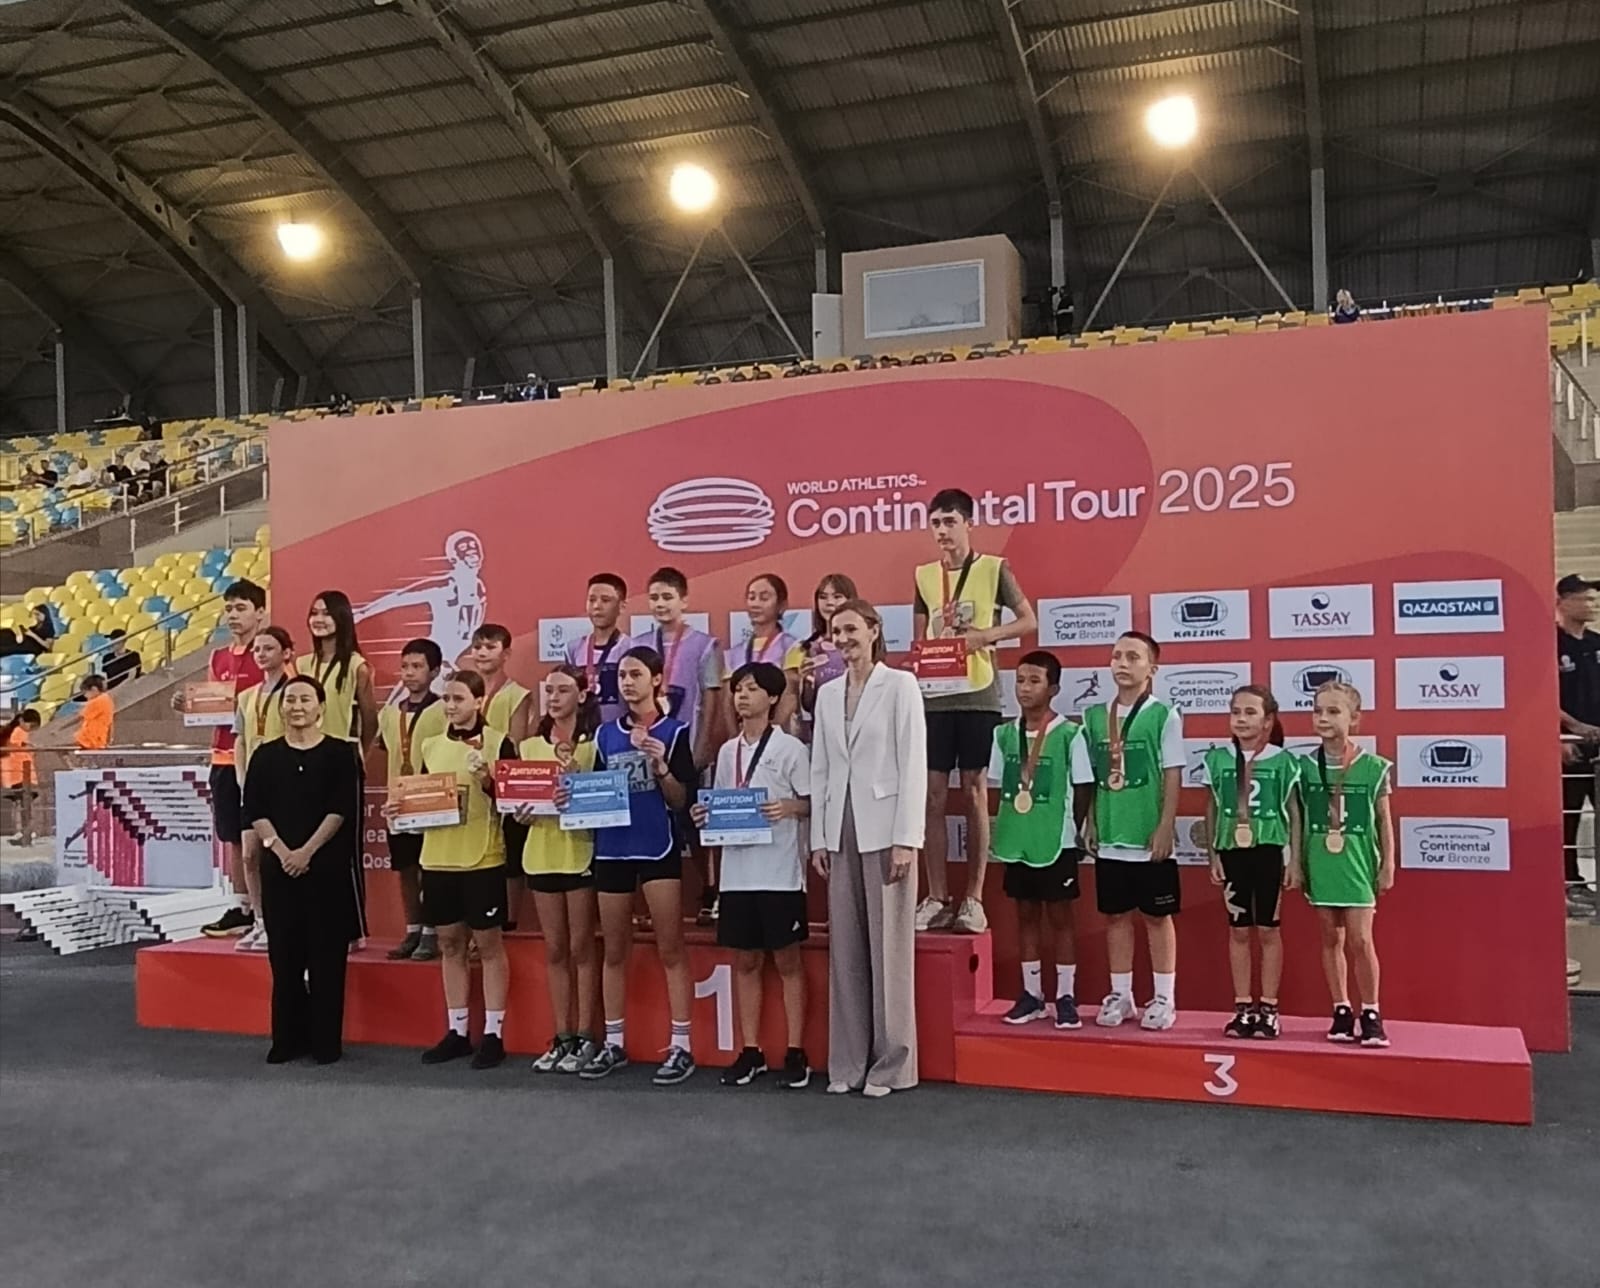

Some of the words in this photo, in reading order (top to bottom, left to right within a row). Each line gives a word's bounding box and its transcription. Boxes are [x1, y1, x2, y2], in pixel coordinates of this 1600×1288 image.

[787, 480, 839, 495] WORLD
[787, 483, 1035, 537] Contintal
[1043, 480, 1146, 521] Tour
[1159, 462, 1296, 514] 2025
[1402, 600, 1483, 615] QAZAQSTAN
[1054, 618, 1115, 629] Continental
[1291, 611, 1351, 626] TASSAY
[1054, 630, 1077, 641] Tour
[1079, 629, 1115, 640] Bronze
[1173, 629, 1226, 638] KAZZINC
[1169, 686, 1234, 696] Continental
[1418, 683, 1480, 698] TASSAY
[1421, 775, 1479, 783] KAZZINC
[1419, 840, 1490, 852] Continental
[1420, 851, 1445, 863] Tour
[1448, 852, 1491, 864] Bronze
[694, 964, 734, 1051] 1
[1203, 1054, 1239, 1096] 3
